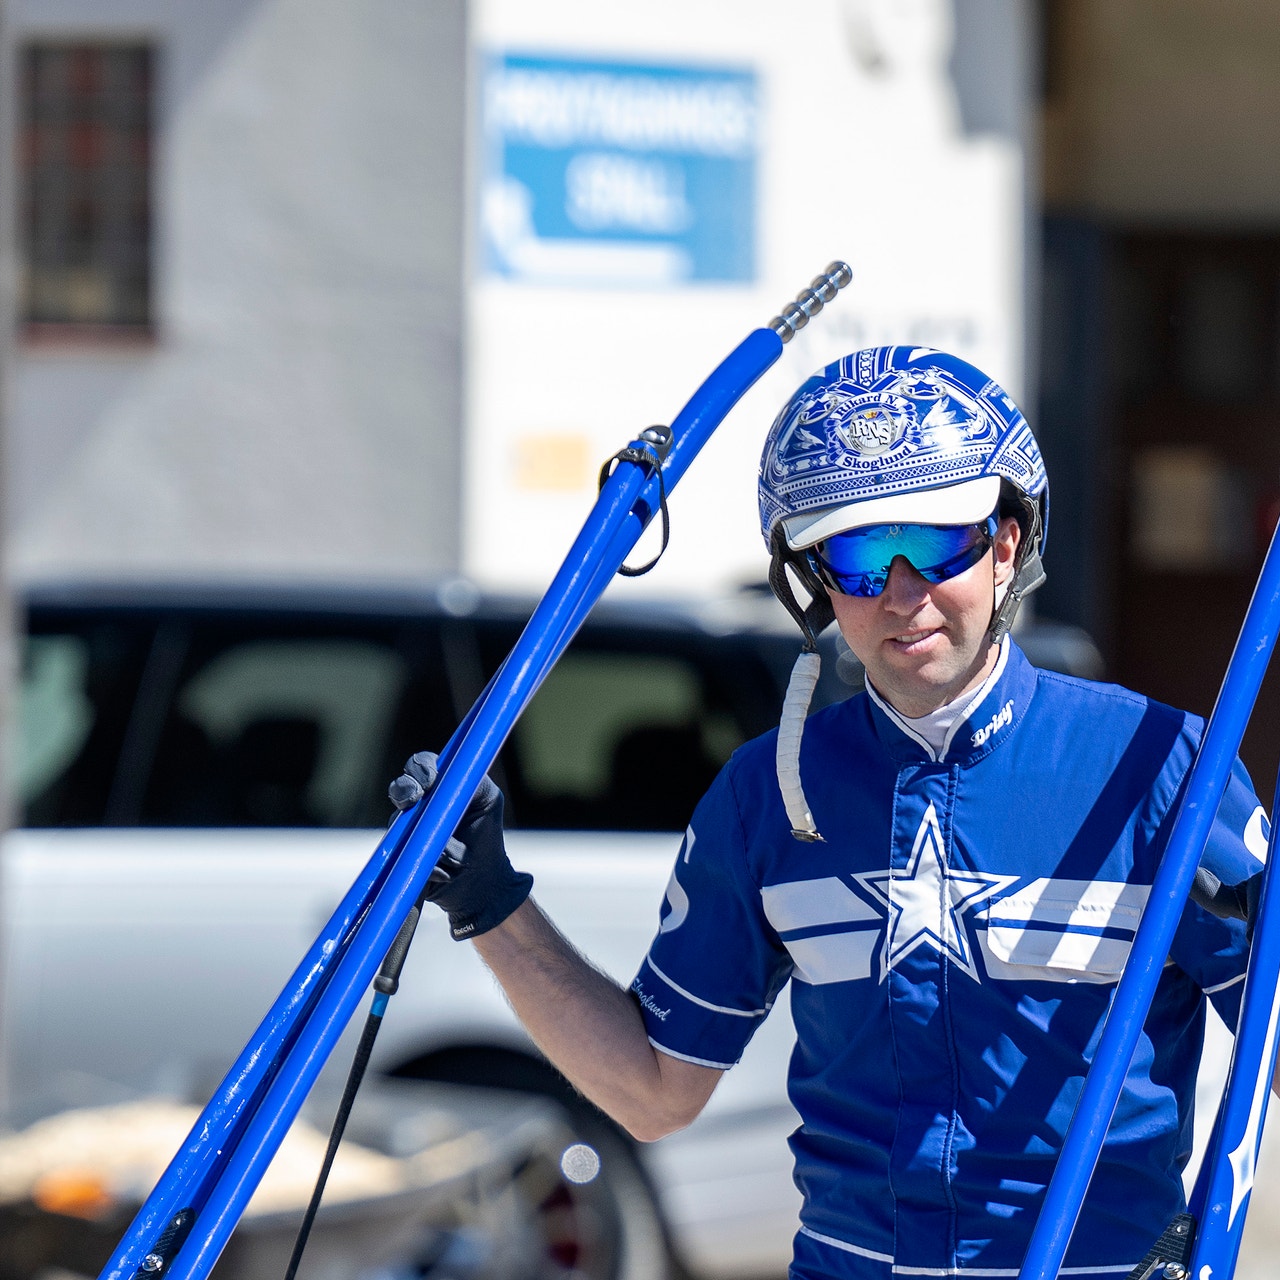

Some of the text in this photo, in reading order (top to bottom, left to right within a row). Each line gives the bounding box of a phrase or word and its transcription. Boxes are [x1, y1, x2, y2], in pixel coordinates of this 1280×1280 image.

[835, 393, 882, 417] Rikard
[852, 419, 891, 446] RNS
[842, 445, 913, 471] Skoglund
[630, 977, 671, 1021] Skoglund
